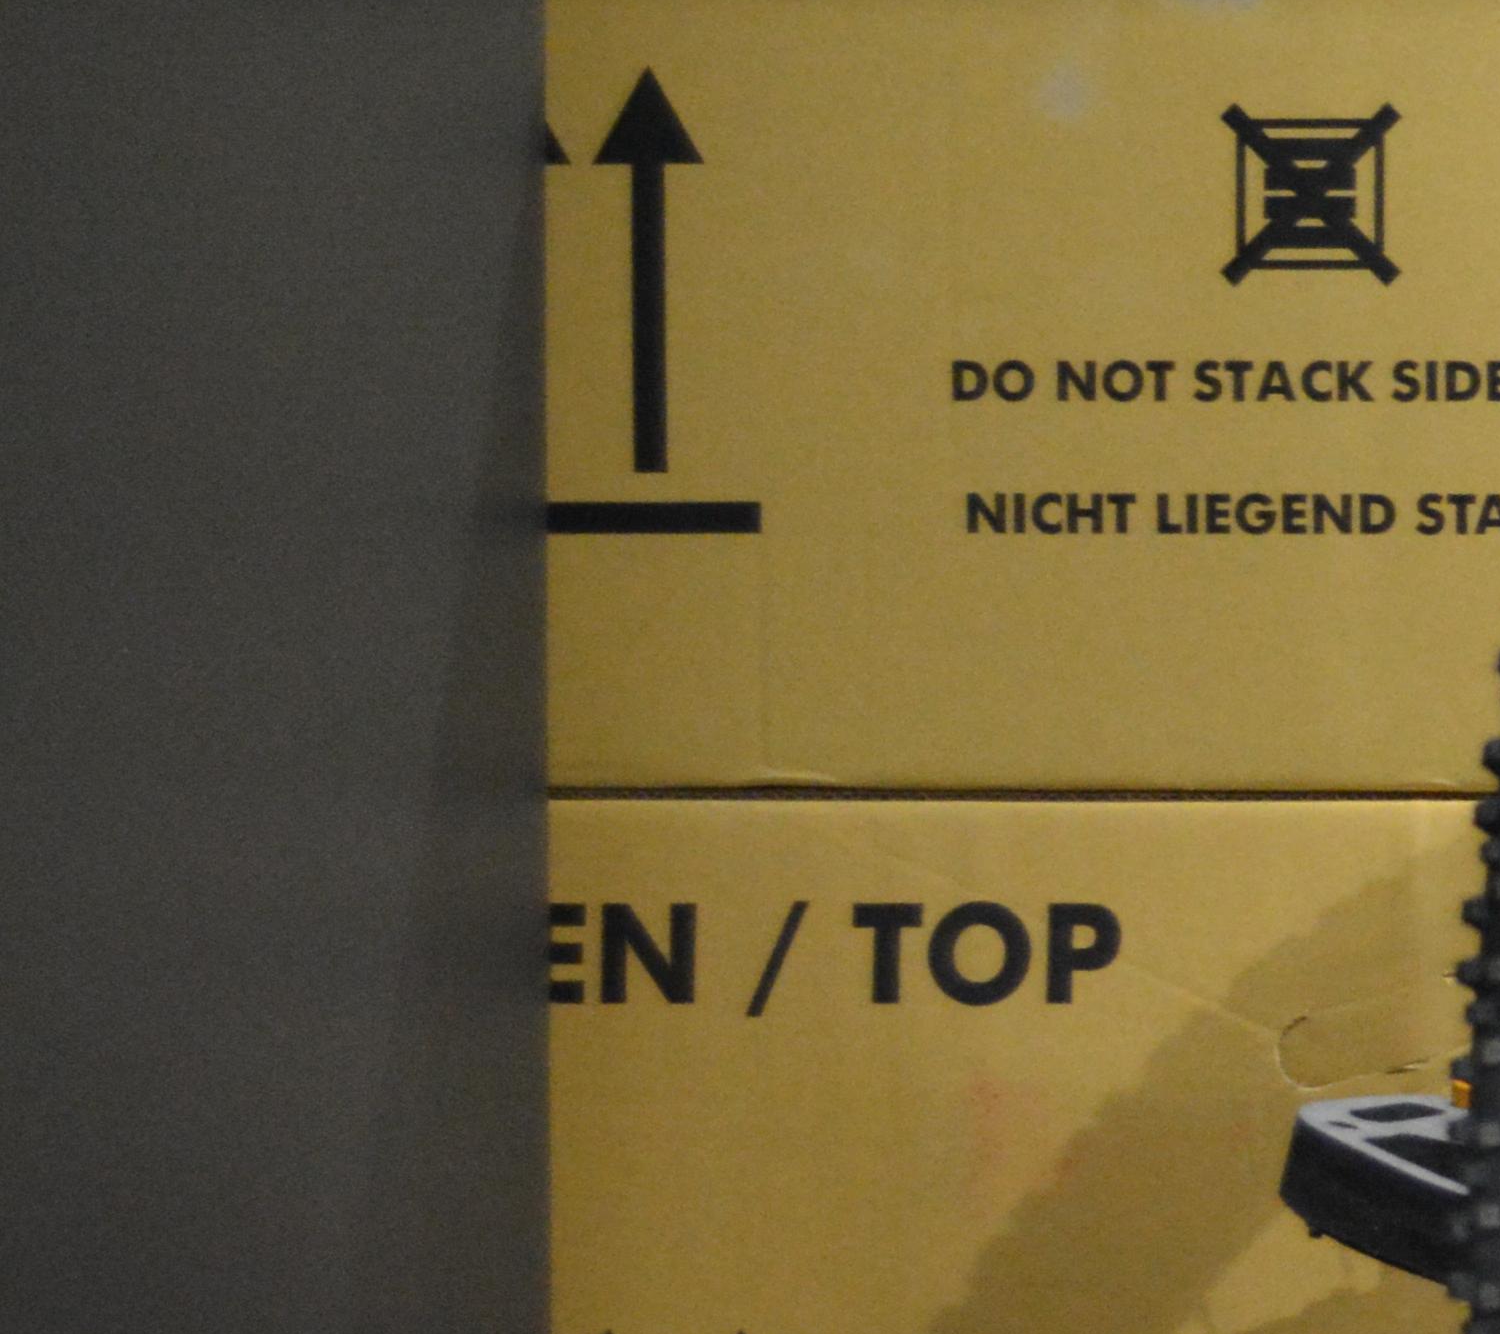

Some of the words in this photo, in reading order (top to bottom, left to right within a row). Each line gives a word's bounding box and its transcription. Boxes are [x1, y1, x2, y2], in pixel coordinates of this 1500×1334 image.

[951, 359, 1036, 403] DO
[1056, 359, 1176, 403] NOT
[1193, 359, 1374, 403] STACK
[966, 492, 1137, 536] NICHT
[1156, 492, 1396, 536] LIEGEND
[552, 902, 696, 1006] EN
[746, 901, 809, 1018] /
[852, 901, 1121, 1007] TOP
